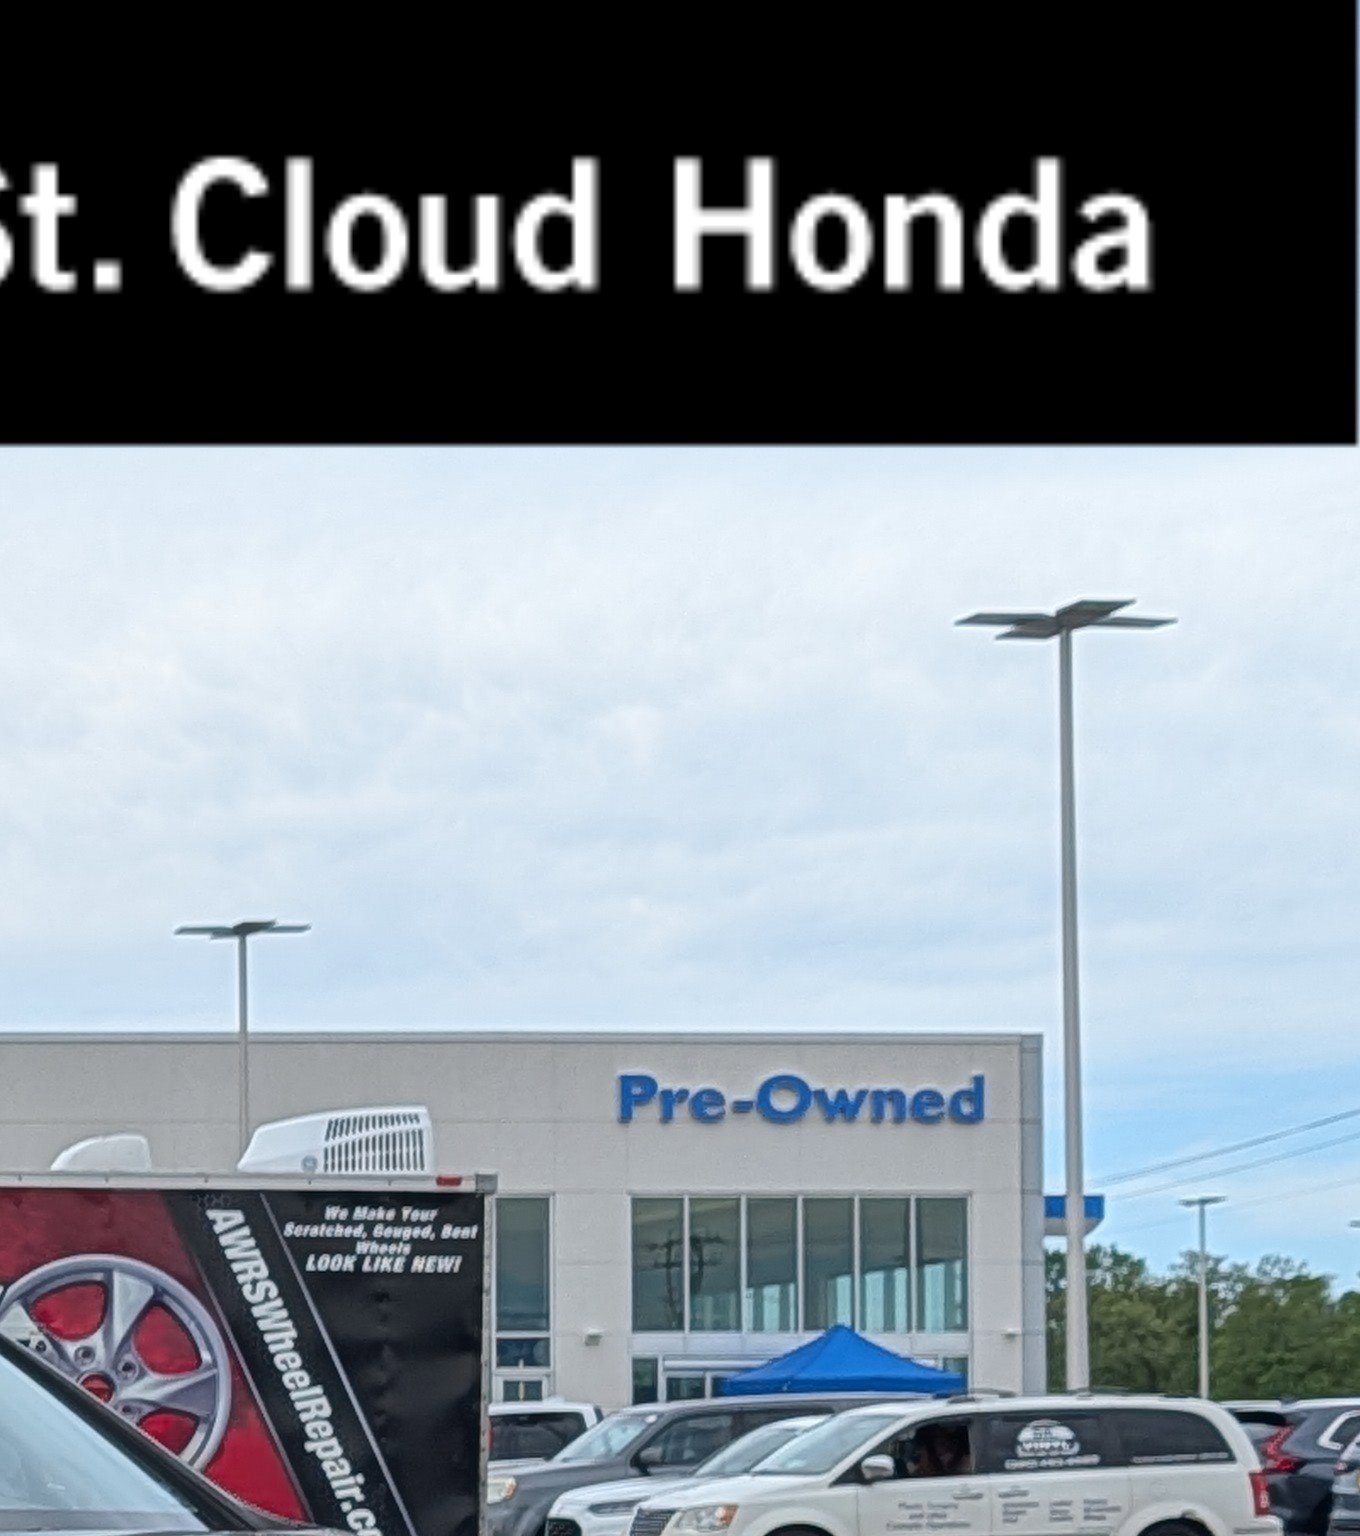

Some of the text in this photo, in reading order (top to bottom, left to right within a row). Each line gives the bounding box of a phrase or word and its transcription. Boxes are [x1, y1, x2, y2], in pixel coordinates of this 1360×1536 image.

[618, 1074, 985, 1124] Pre-Owned
[325, 1206, 438, 1222] We Make Your
[283, 1221, 367, 1239] Scratched,
[355, 1241, 412, 1256] Wheels
[306, 1253, 463, 1273] LOOK LIKE NEW!
